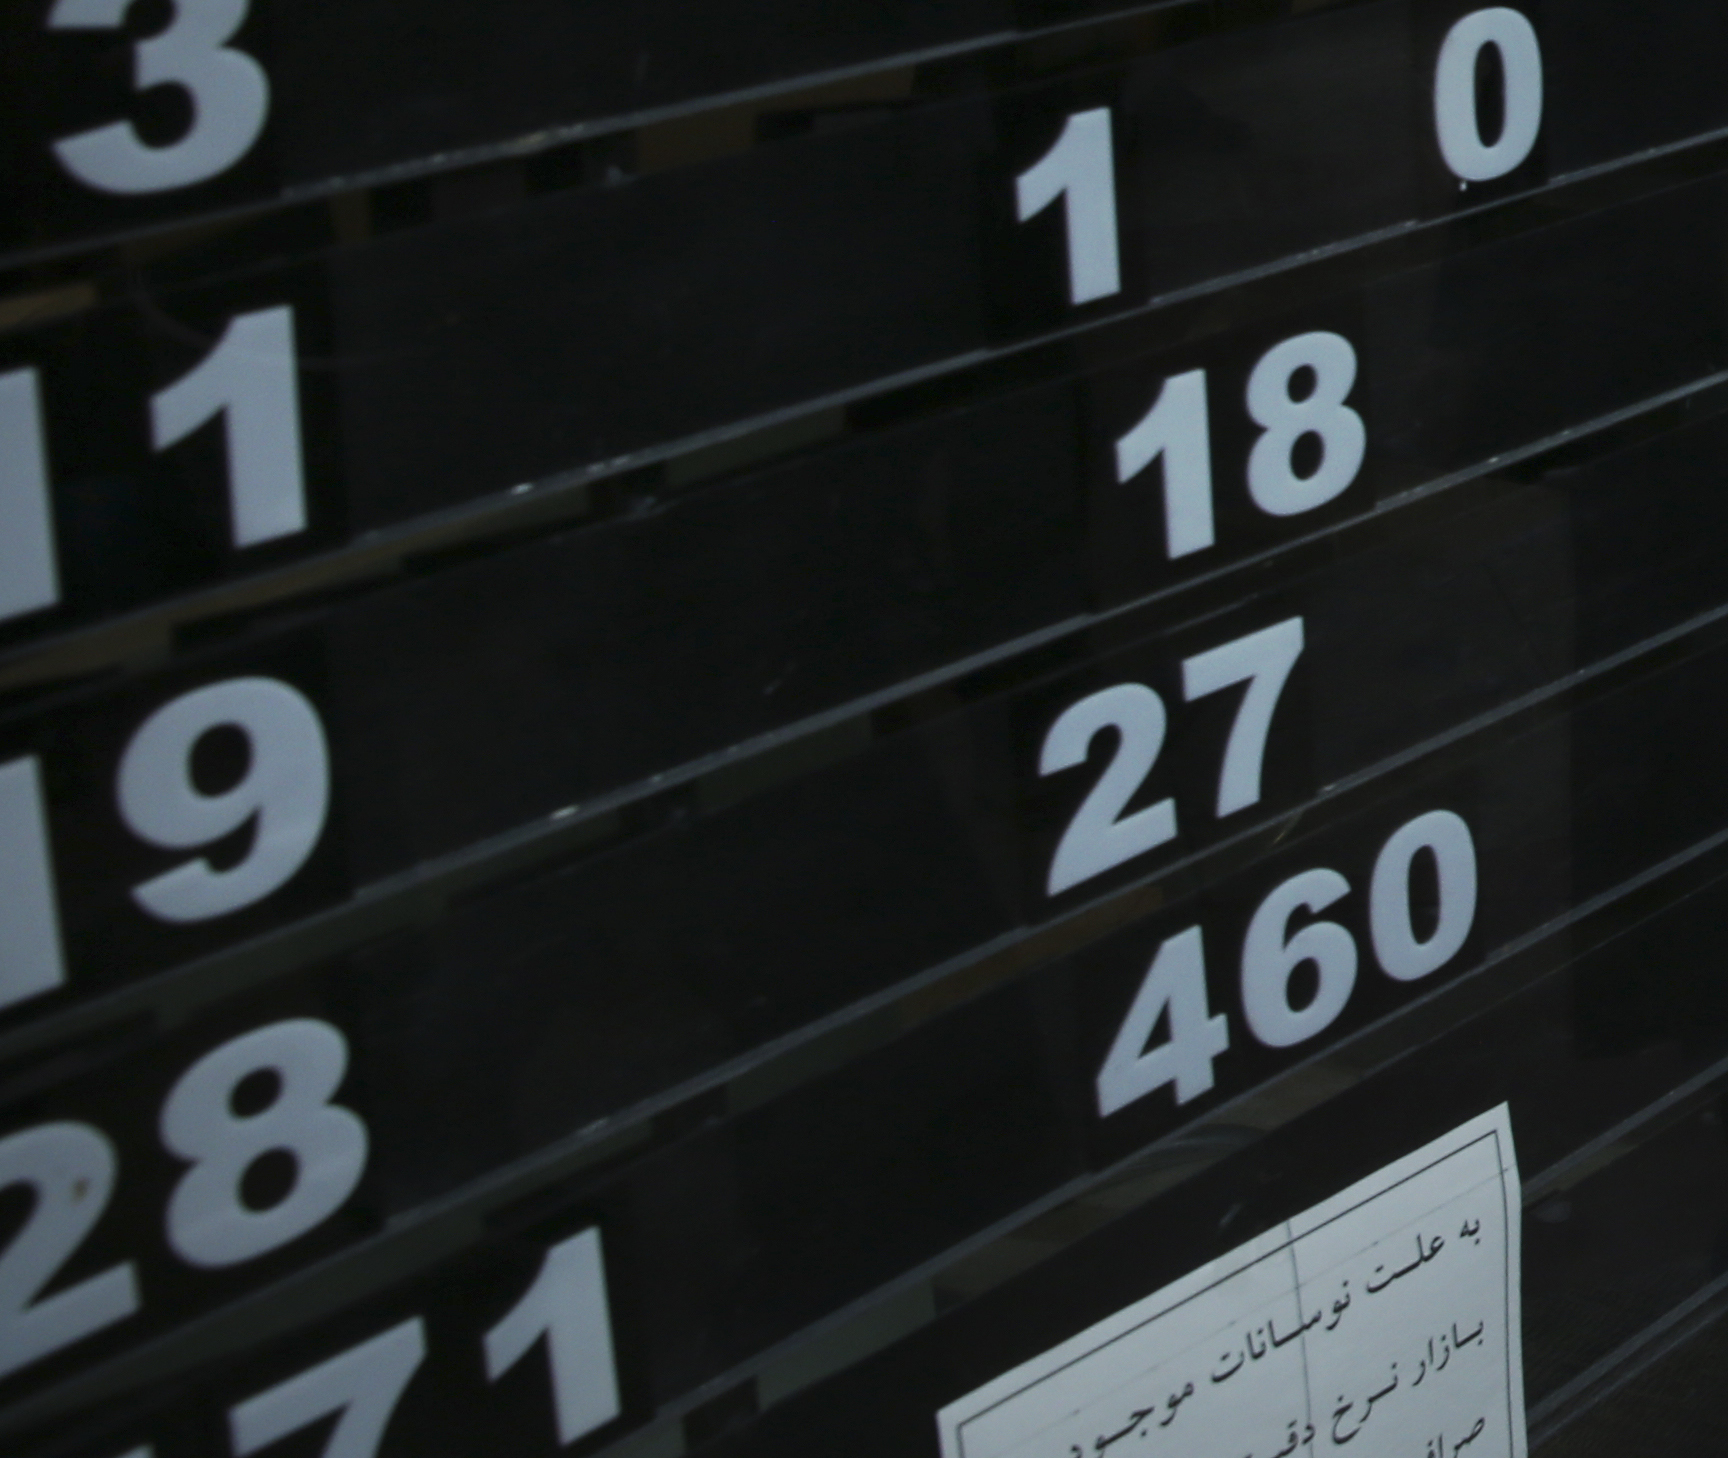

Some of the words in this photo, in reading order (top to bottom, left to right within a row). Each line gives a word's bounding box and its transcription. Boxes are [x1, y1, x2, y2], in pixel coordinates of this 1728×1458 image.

[1114, 329, 1367, 560] 18
[1038, 615, 1305, 896] 27
[1096, 808, 1478, 1117] 460
[1365, 1233, 1445, 1293] علت
[1459, 1217, 1481, 1245] به
[118, 1225, 621, 1458] 71
[1210, 1280, 1351, 1384] نوسانات
[1411, 1319, 1485, 1387] بازار
[1331, 1362, 1399, 1445] نرخ
